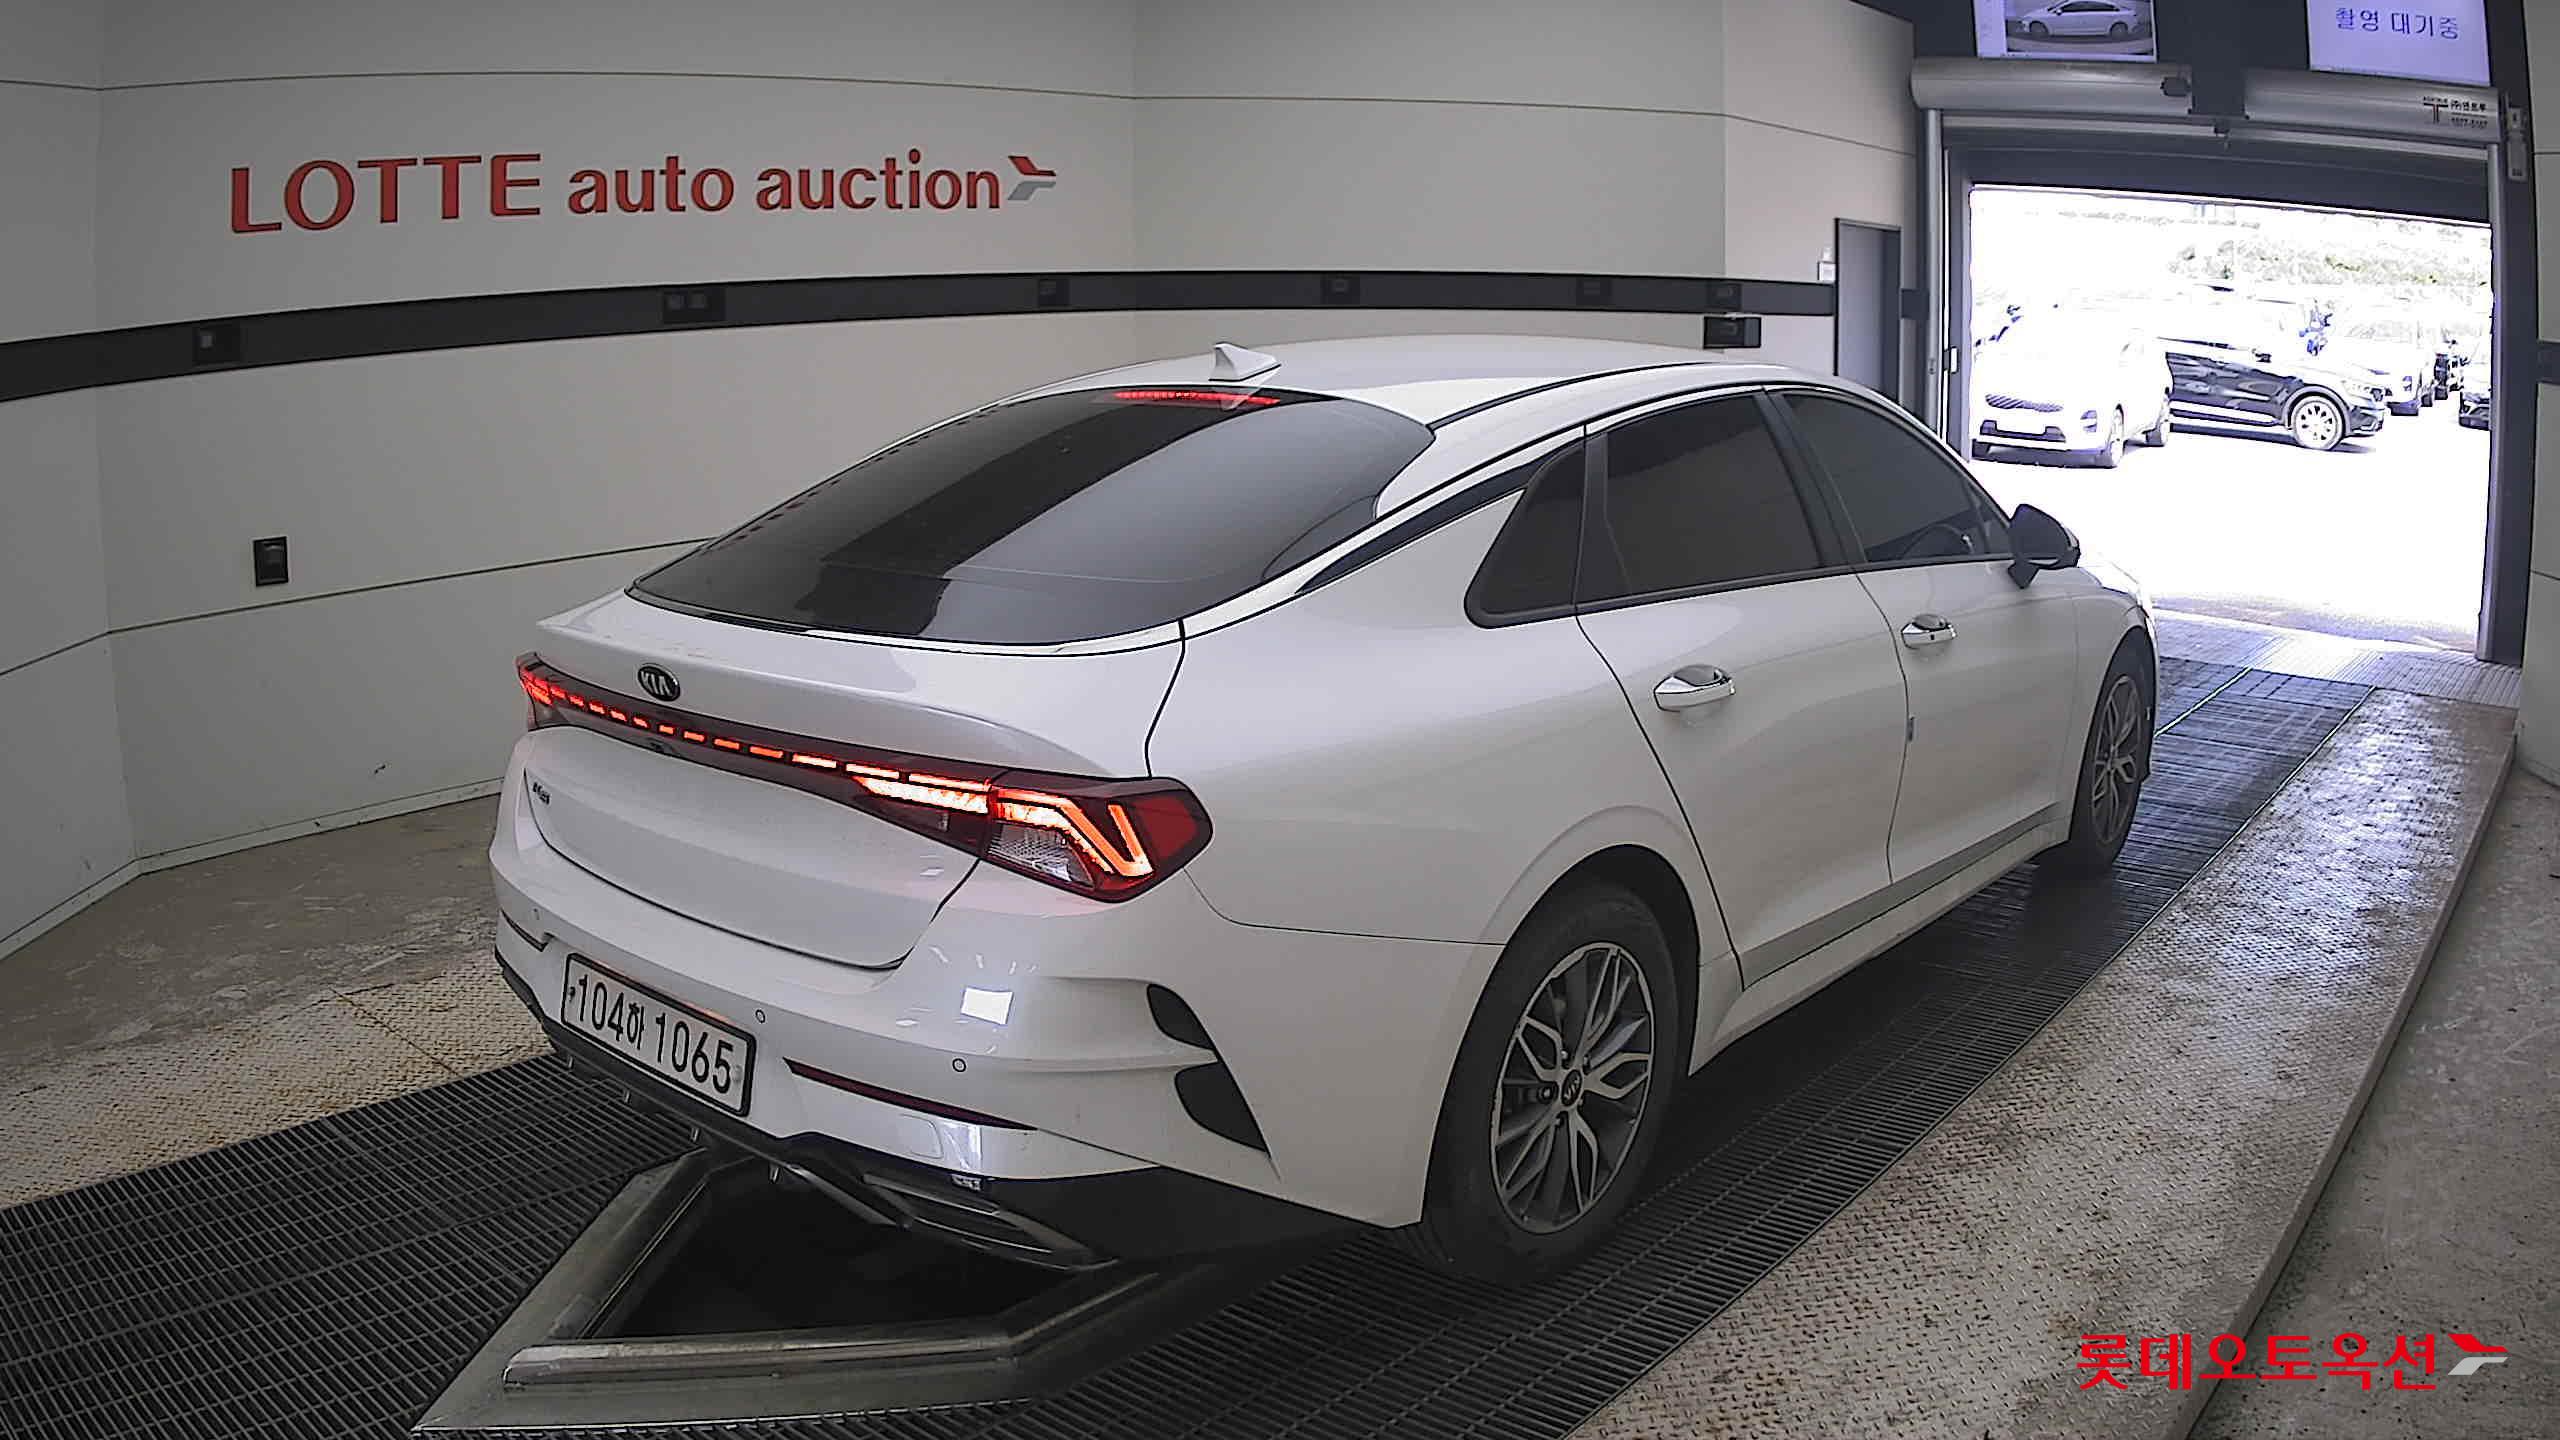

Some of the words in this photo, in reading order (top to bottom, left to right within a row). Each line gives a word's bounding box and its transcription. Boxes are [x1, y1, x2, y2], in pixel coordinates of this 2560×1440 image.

[2336, 8, 2379, 32] 촬영
[2391, 12, 2459, 40] 대기중
[230, 153, 542, 234] LOTTE
[567, 155, 736, 215] auto
[756, 148, 1002, 211] auction
[640, 669, 672, 698] KIA
[577, 974, 645, 1050] 104하
[655, 1012, 734, 1094] 1065
